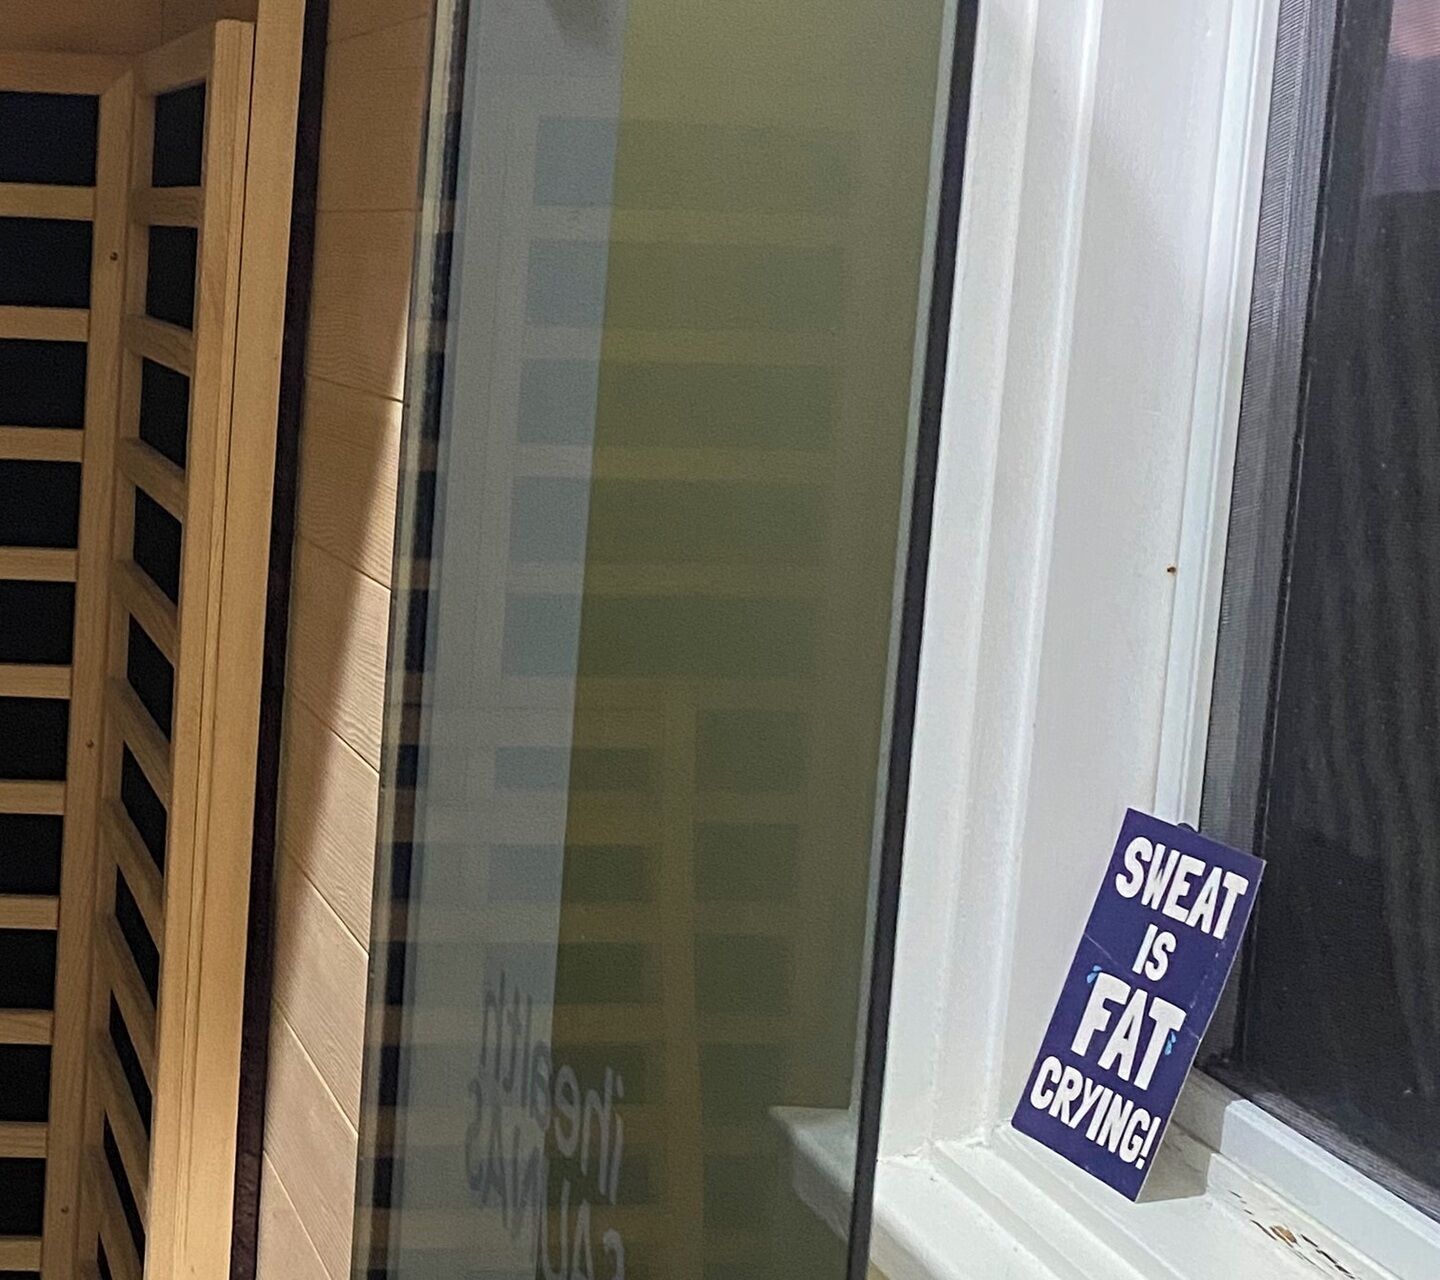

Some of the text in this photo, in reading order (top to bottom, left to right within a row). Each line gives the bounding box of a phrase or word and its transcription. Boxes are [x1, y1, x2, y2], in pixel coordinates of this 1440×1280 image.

[1115, 837, 1249, 940] SWEAT
[1131, 923, 1177, 981] IS
[1070, 971, 1187, 1090] FAT
[1029, 1055, 1161, 1169] CRYING!
